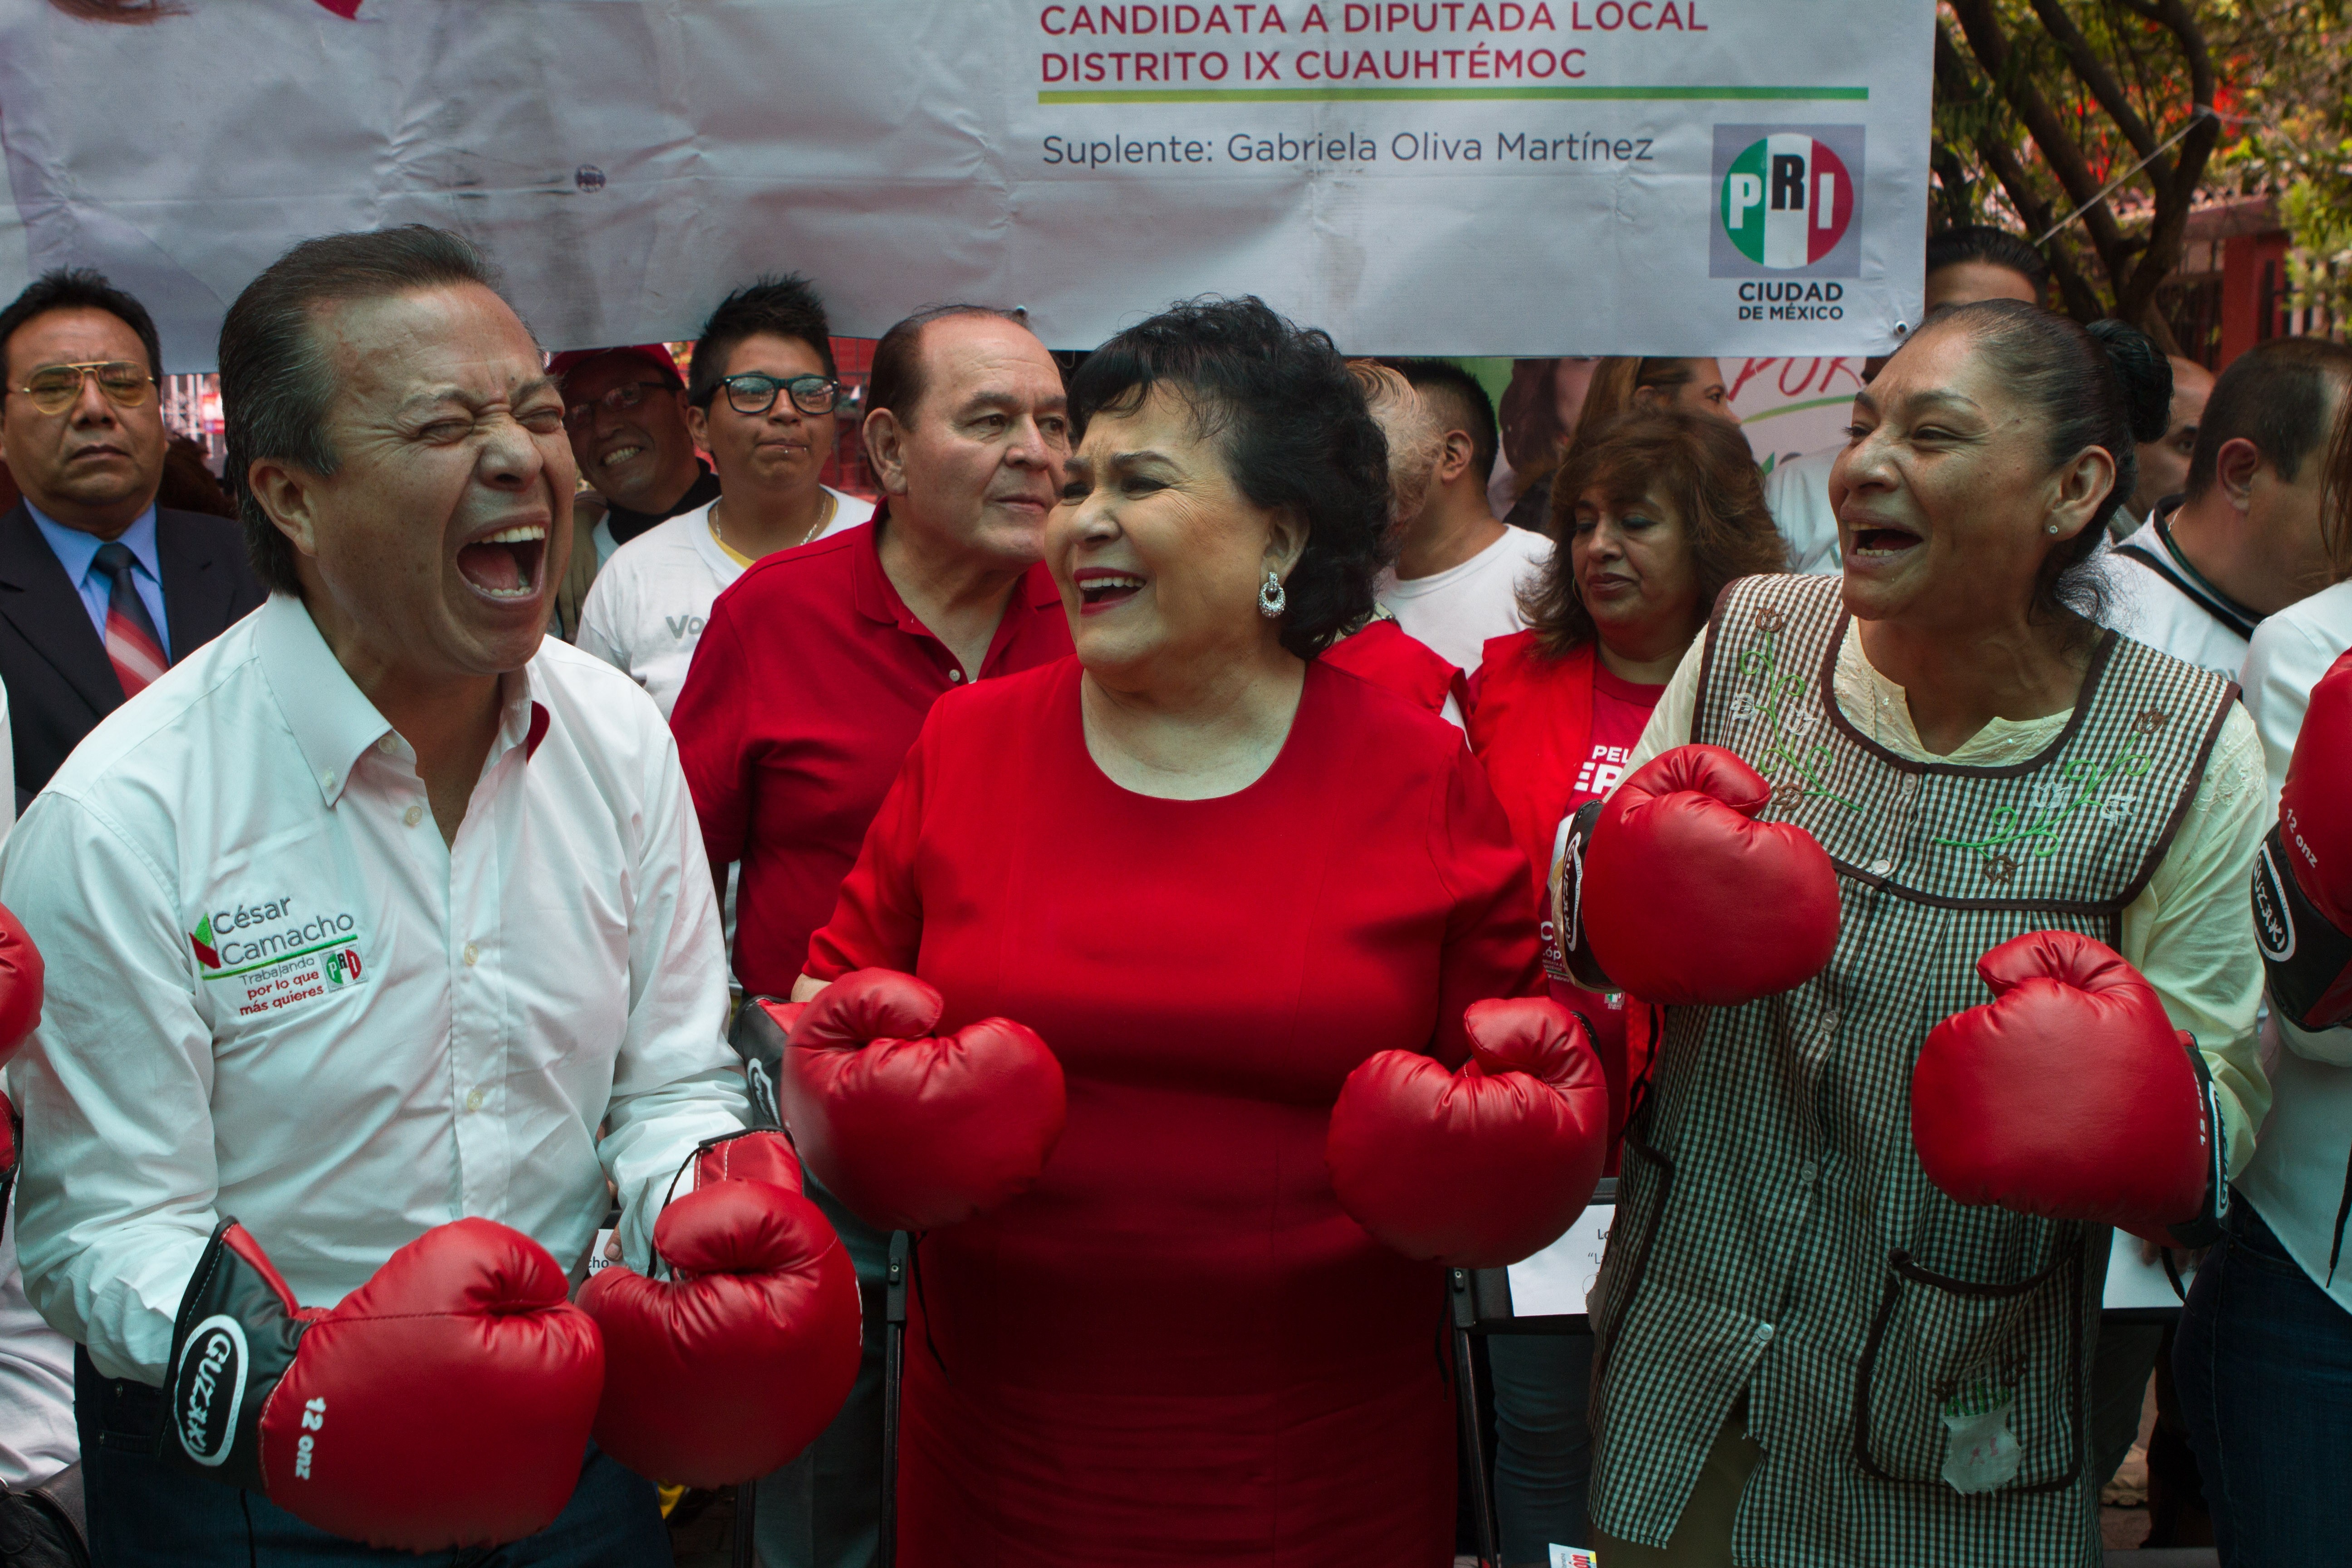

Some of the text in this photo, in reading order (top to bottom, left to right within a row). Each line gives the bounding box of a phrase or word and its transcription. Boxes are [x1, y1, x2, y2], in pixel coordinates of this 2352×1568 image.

[1040, 1, 1708, 35] CANDIDATA A DIPUTADA LOCAL
[1042, 42, 1586, 82] DISTRITO IX CUAUHTÉMOC
[1043, 131, 1654, 168] Suplente: Gabriela Oliva Martínez
[1728, 154, 1835, 230] PRI
[1738, 282, 1844, 303] CIUDAD
[1738, 303, 1844, 321] DE MÉXICO
[2287, 808, 2318, 868] 12 onz
[213, 897, 291, 935] César
[221, 912, 354, 965] Camacho
[239, 956, 315, 986] Trabajando
[328, 952, 359, 980] PRI
[239, 984, 325, 1017] más quieres
[247, 970, 320, 1001] por lo que
[295, 1396, 327, 1480] 12 onz
